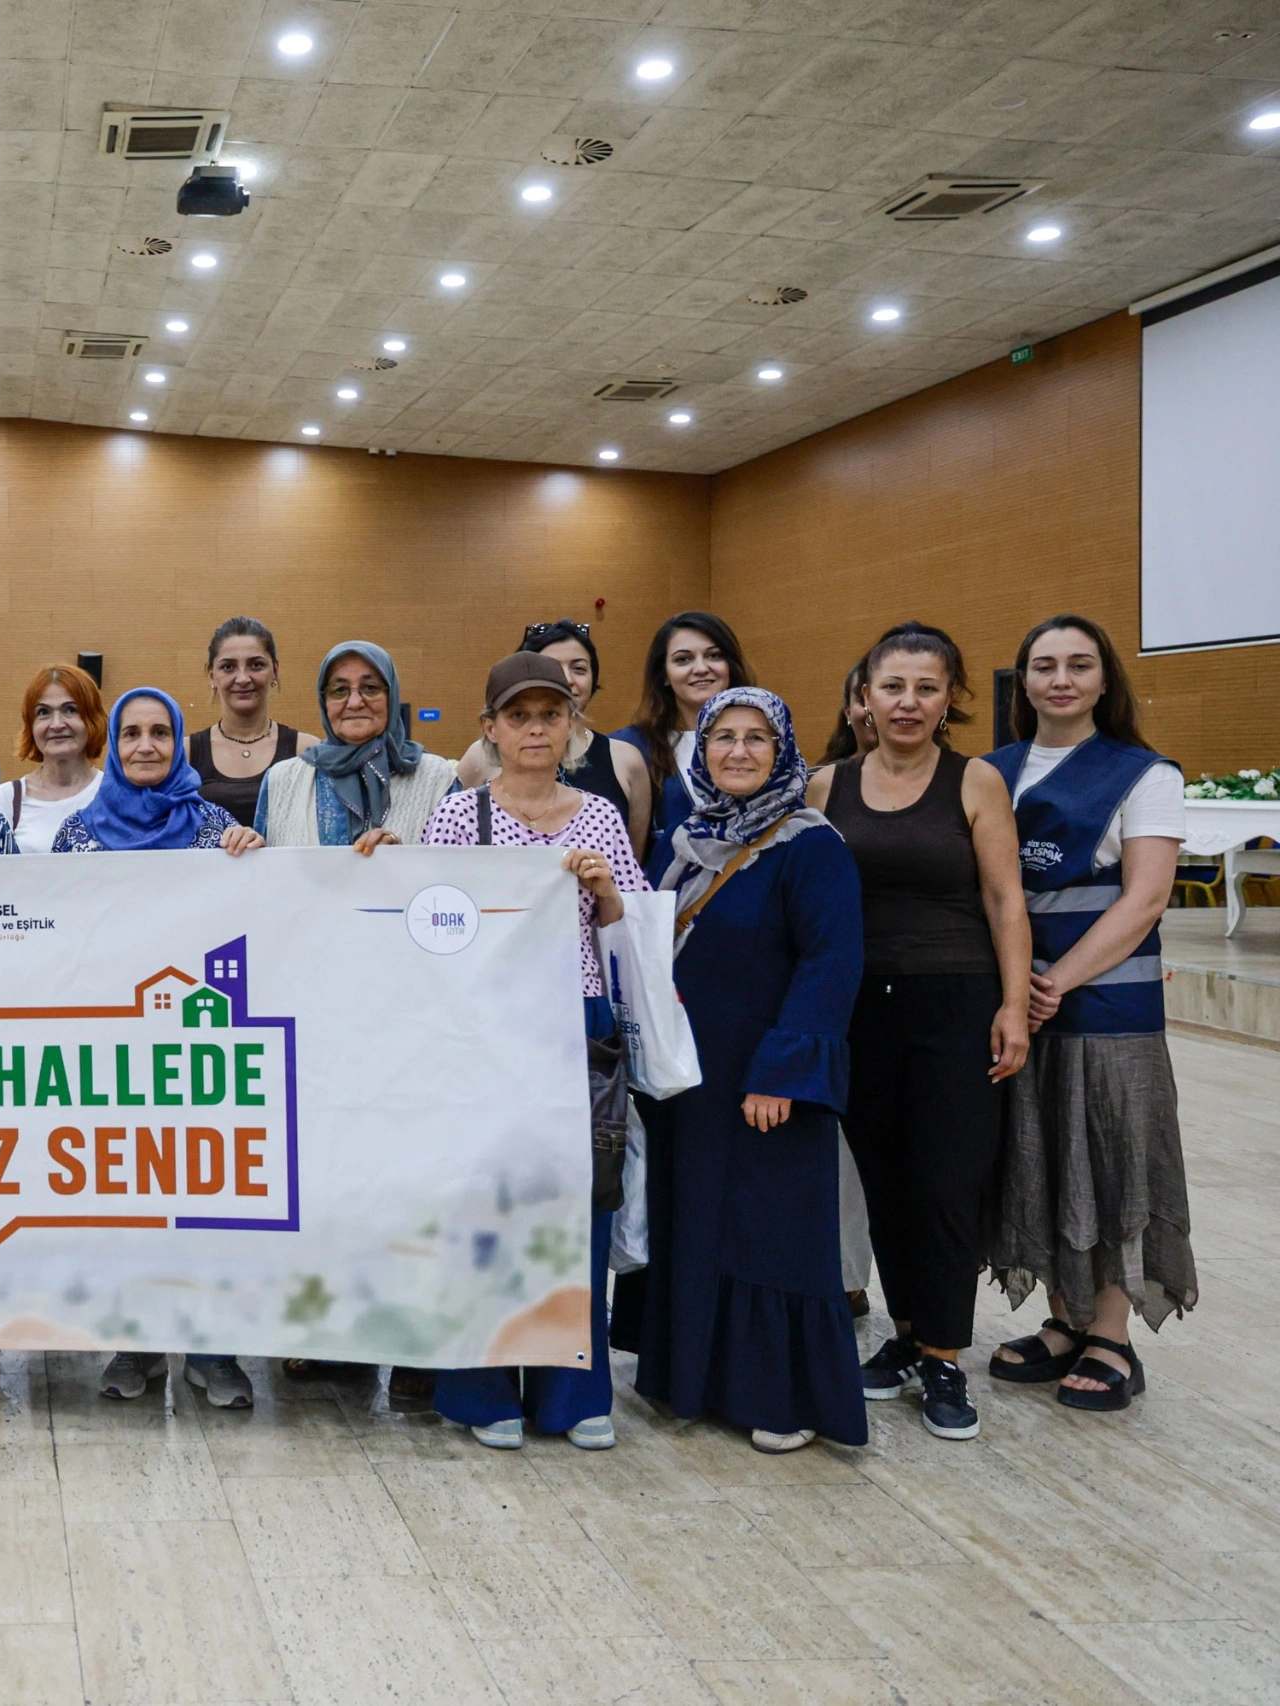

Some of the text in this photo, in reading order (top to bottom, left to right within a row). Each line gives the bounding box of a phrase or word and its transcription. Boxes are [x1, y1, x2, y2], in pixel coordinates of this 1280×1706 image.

[2, 922, 14, 930] ve
[16, 917, 55, 931] EŞİTLİK
[431, 912, 466, 927] ODAK
[47, 1126, 269, 1197] SENDE
